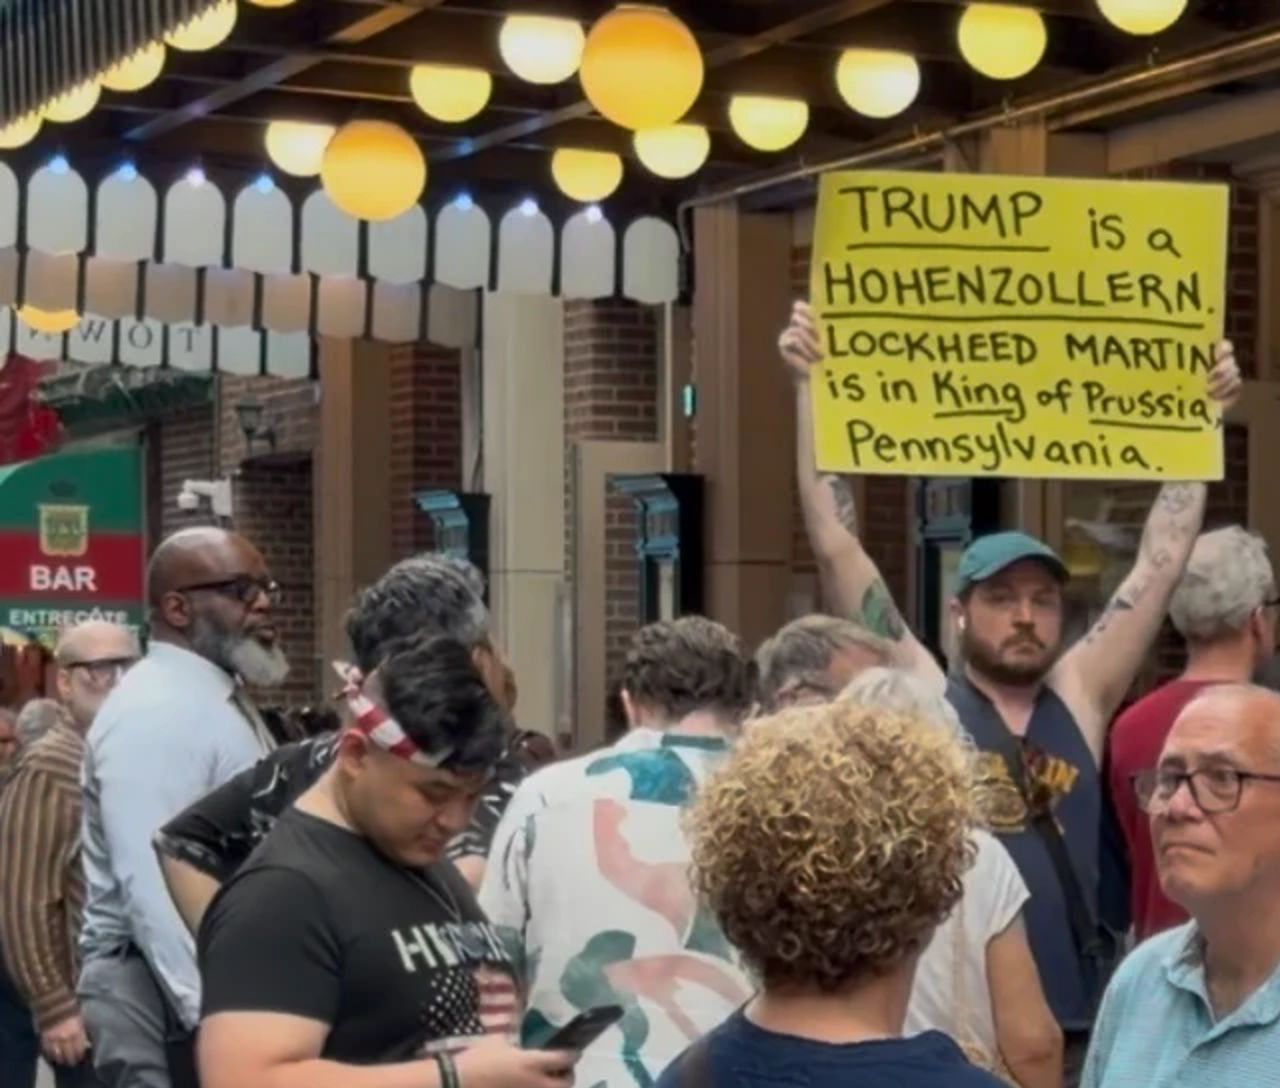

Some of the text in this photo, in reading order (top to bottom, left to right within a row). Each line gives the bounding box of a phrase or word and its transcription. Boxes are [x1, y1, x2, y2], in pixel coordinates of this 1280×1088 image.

[838, 186, 1181, 258] TRUMP is a
[823, 262, 1216, 315] HOHENZOLLERN.
[826, 324, 1217, 375] LOCKHEED MARTIN
[825, 370, 865, 402] is
[877, 371, 917, 403] in
[932, 370, 1027, 423] King
[1036, 379, 1073, 413] of
[845, 419, 1164, 471] Pennsylvania.
[29, 564, 98, 592] BAR
